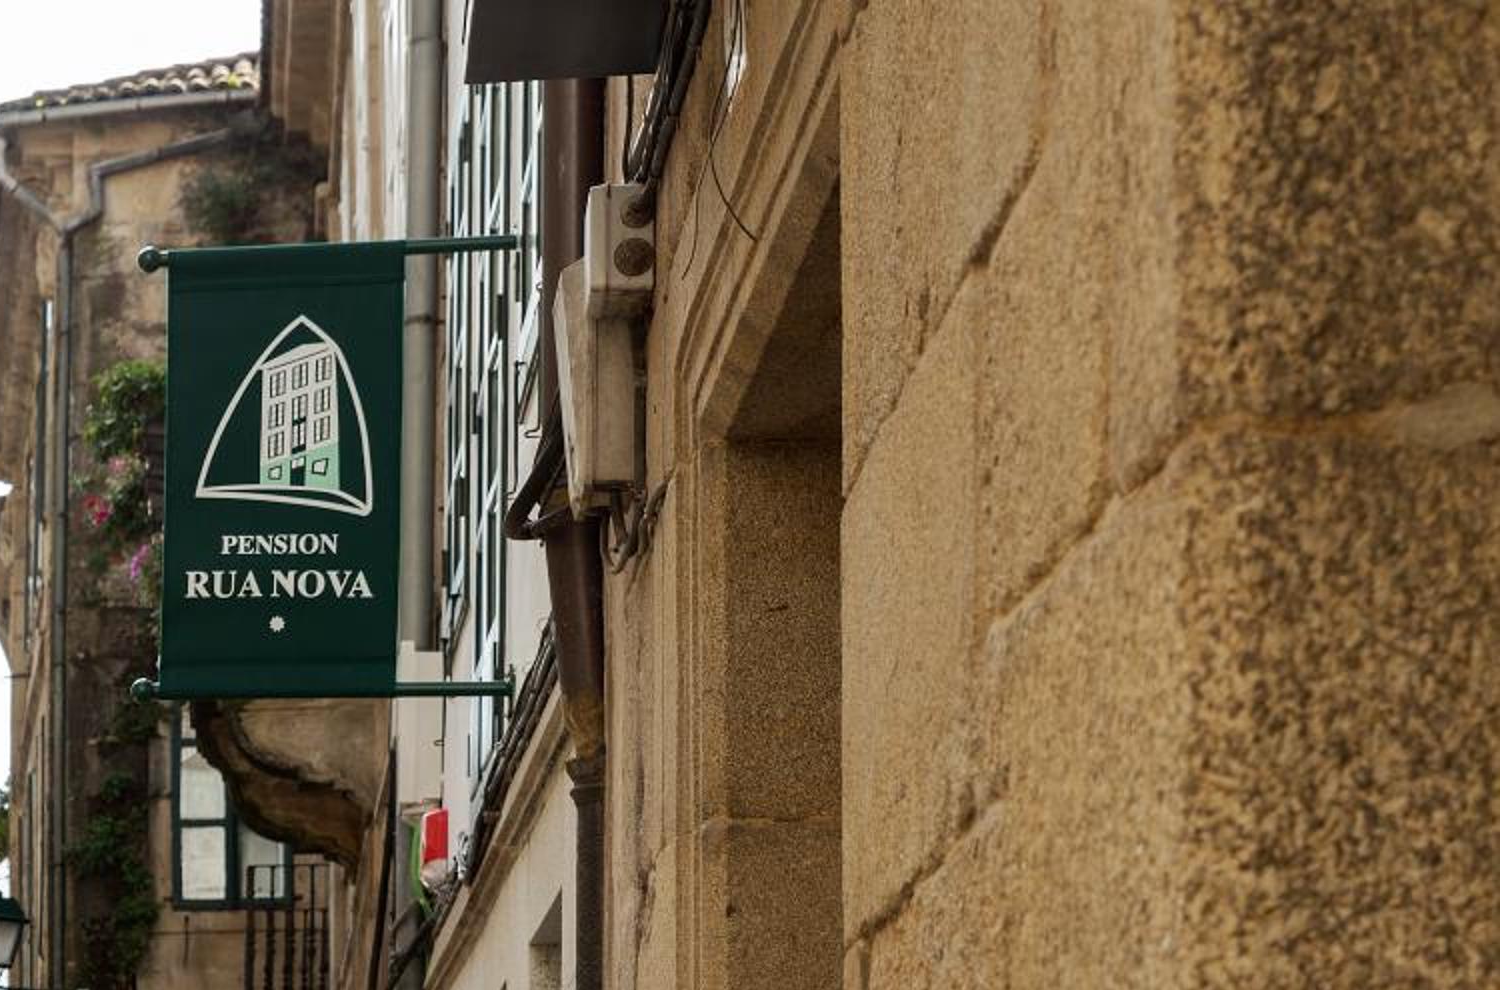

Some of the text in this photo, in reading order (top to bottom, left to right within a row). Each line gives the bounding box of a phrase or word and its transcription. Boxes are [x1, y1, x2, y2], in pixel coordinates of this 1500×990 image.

[221, 533, 339, 555] PENSION
[184, 569, 373, 599] RUA NOVA
